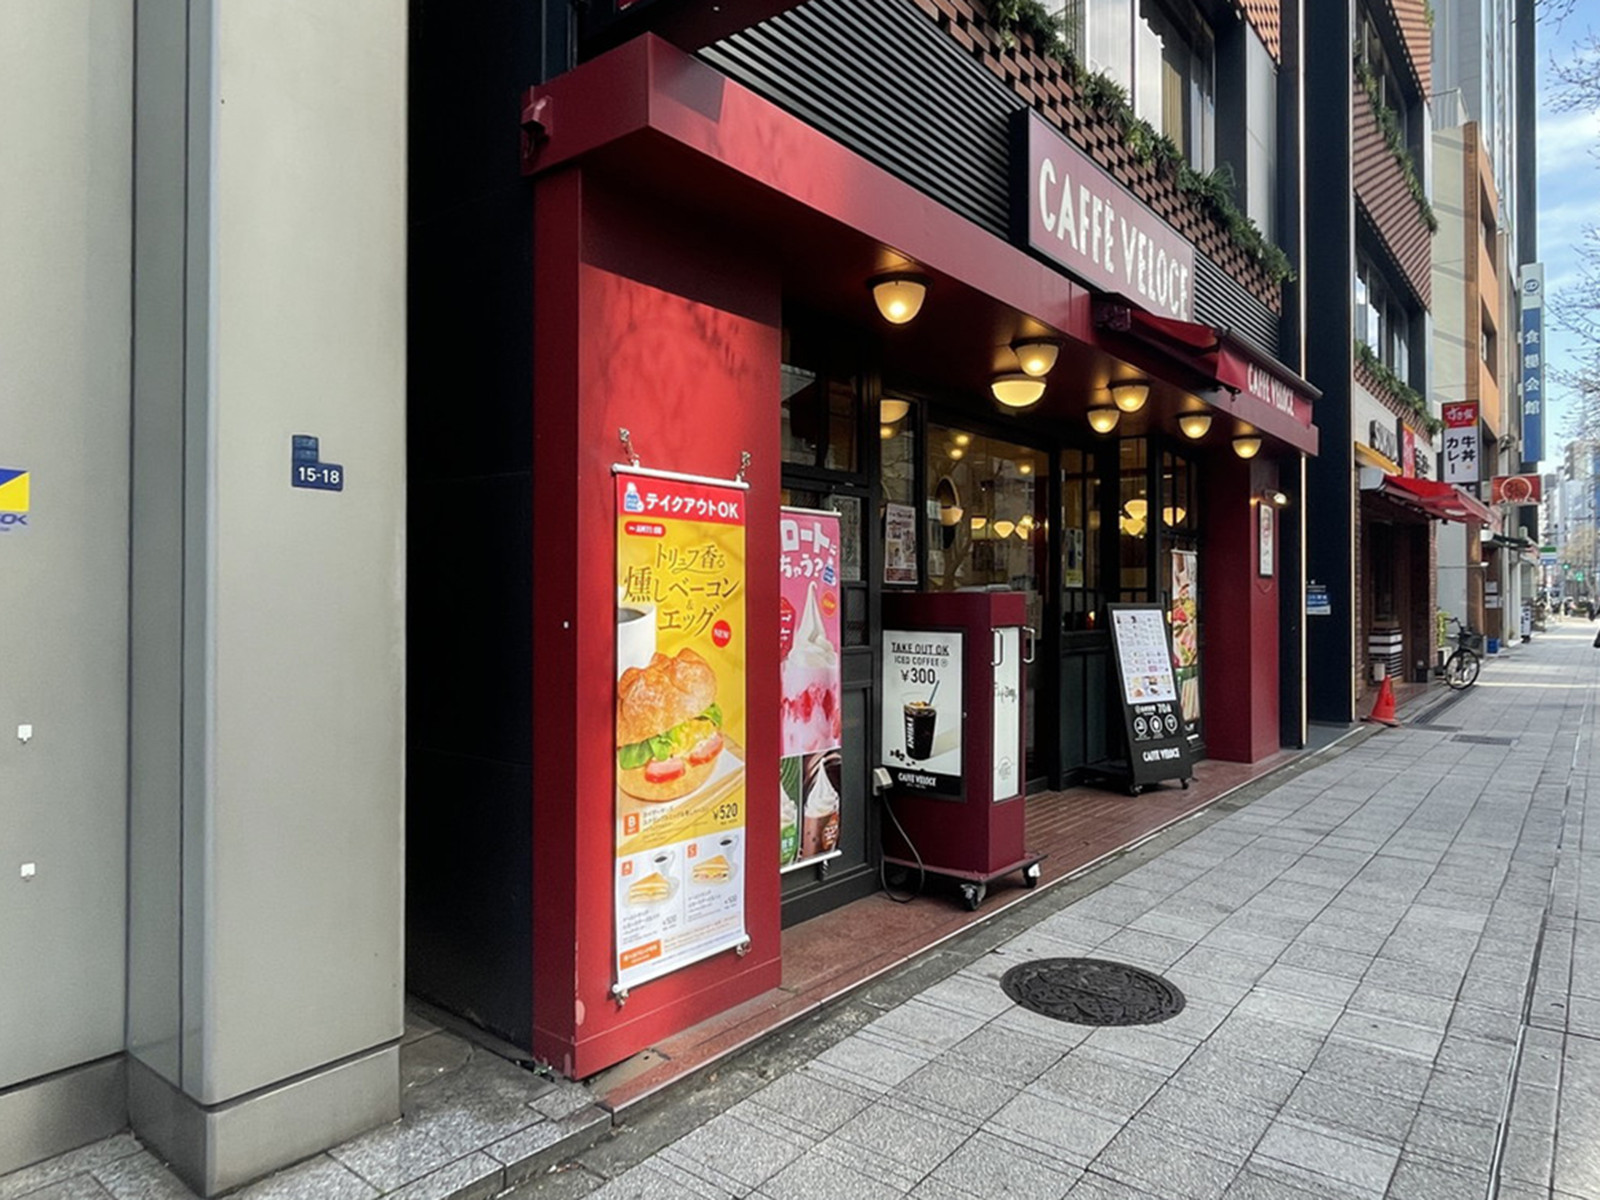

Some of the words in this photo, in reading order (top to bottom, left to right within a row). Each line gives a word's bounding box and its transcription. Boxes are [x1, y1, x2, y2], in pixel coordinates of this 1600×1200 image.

[1039, 157, 1114, 274] CAFFÈ
[1120, 216, 1188, 321] VELOCE
[1446, 437, 1459, 475] カレー
[299, 466, 340, 484] 15-18
[645, 493, 739, 519] テイクアウトOK
[622, 565, 740, 603] 燻しベーコン
[657, 604, 720, 637] エッグ
[891, 642, 912, 652] TAKE
[915, 643, 933, 654] OUT
[935, 644, 949, 655] OK
[894, 655, 910, 664] ICED
[912, 656, 939, 667] COFFEE
[900, 667, 936, 685] ¥300
[713, 803, 739, 821] ¥520
